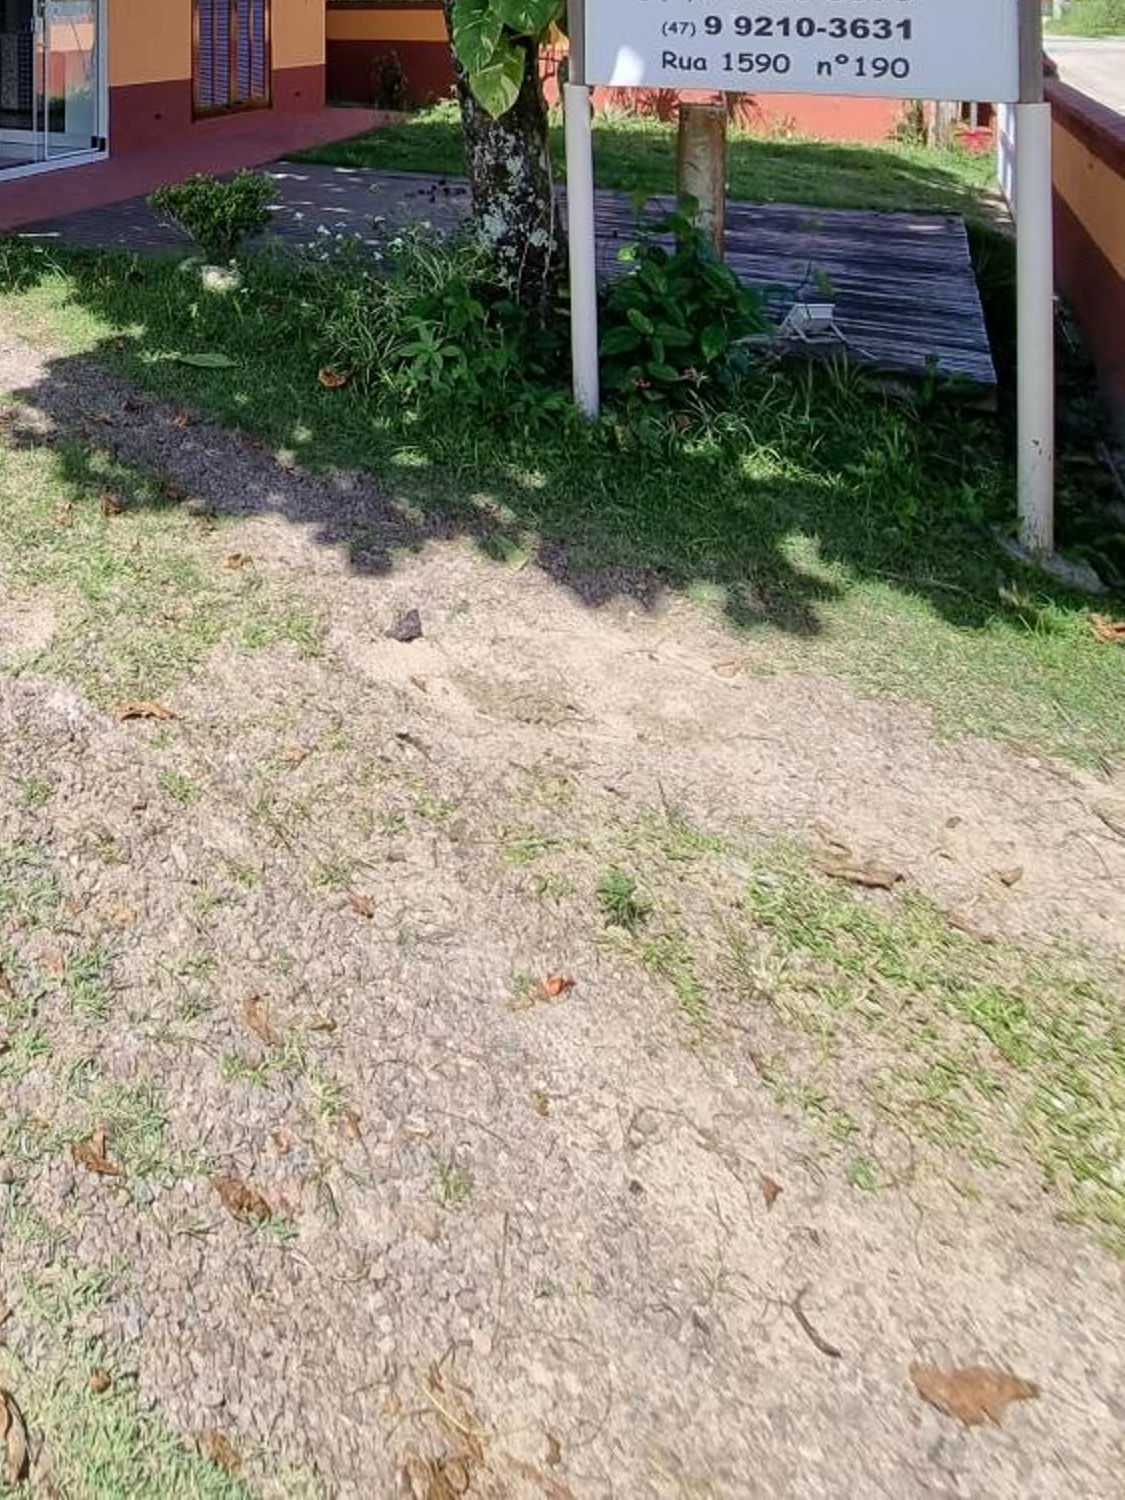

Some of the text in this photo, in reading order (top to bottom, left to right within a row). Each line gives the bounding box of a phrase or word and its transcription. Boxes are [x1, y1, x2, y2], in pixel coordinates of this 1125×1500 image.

[662, 15, 912, 40] (47) 9 9210-3631
[662, 50, 708, 71] Rua
[723, 52, 791, 74] 1590
